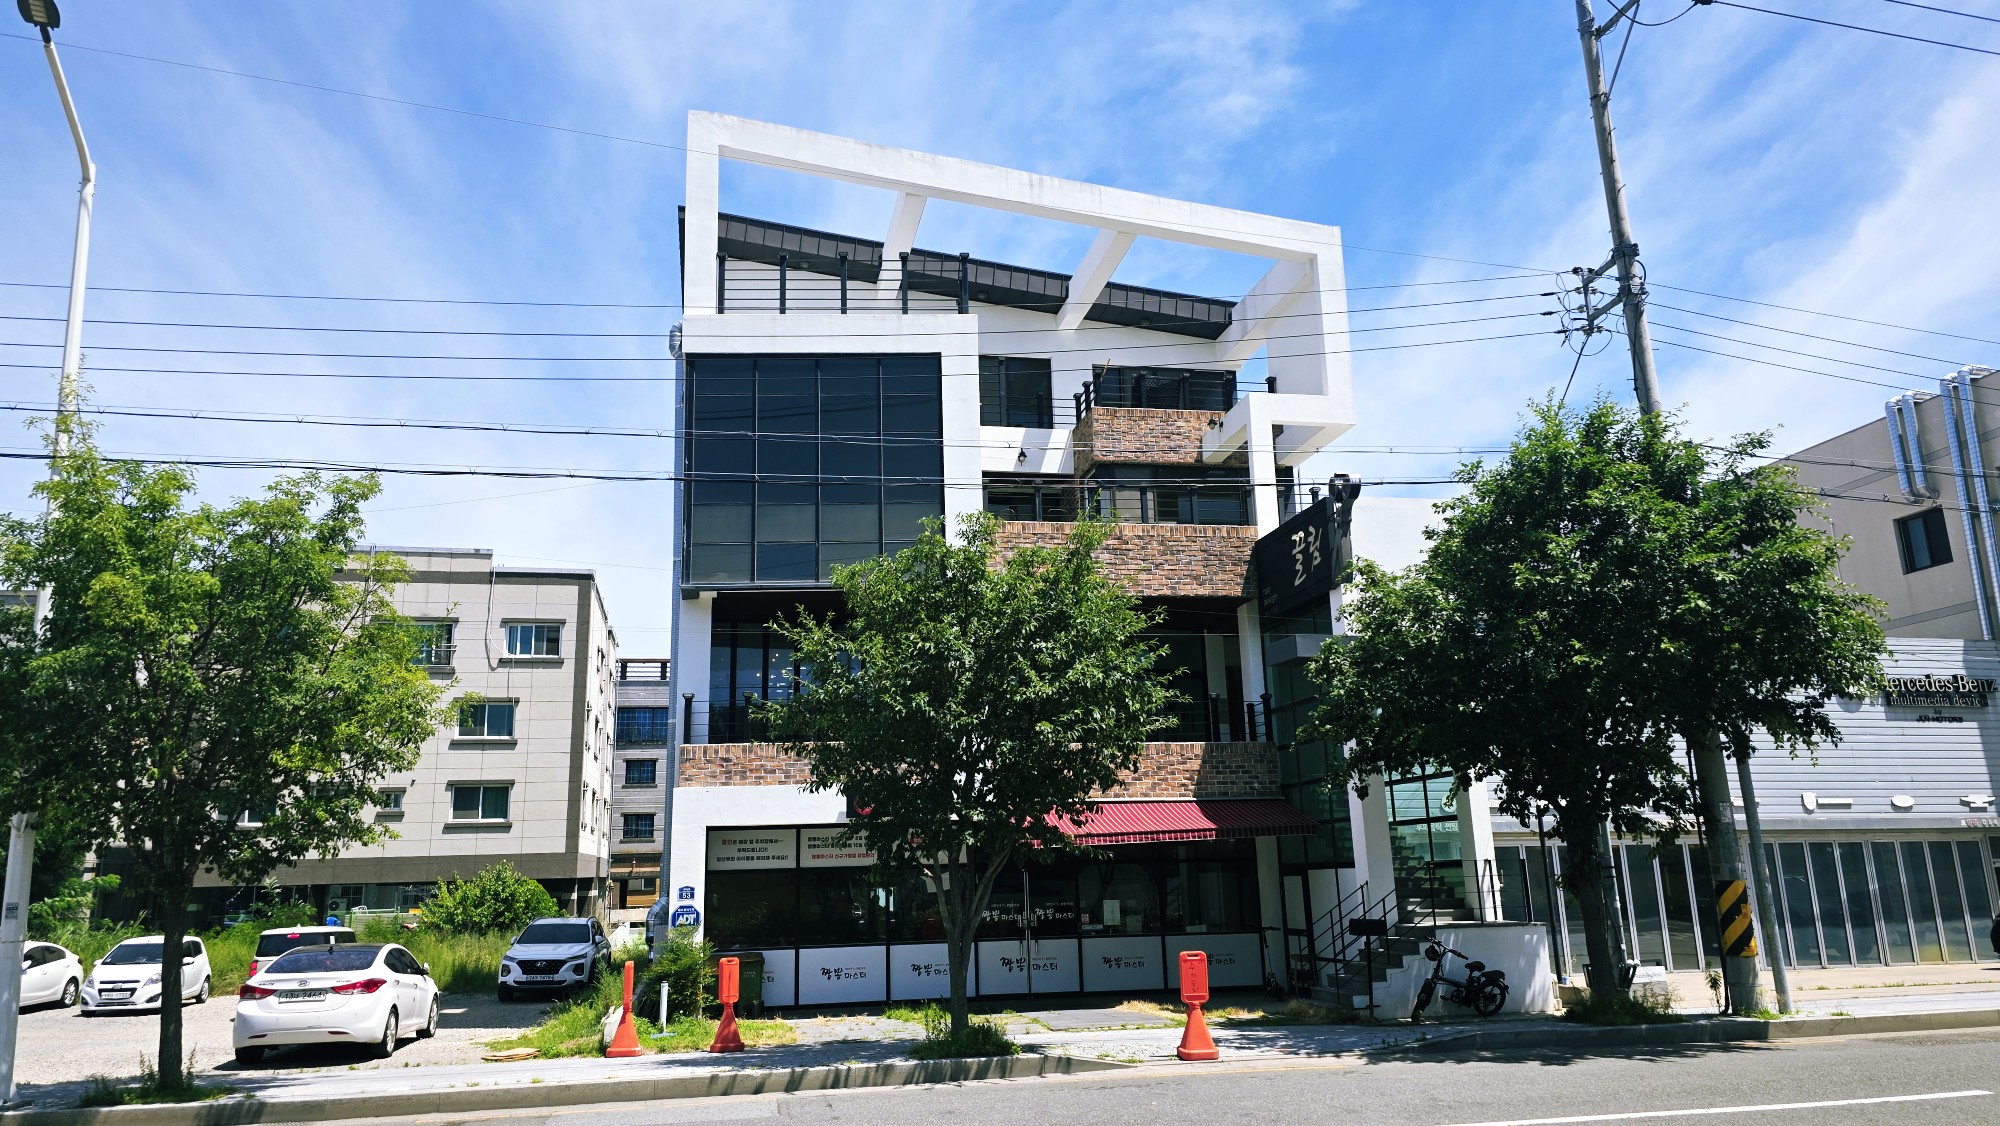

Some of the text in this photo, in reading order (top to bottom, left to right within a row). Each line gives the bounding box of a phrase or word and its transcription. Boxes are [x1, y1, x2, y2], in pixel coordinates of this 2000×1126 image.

[1291, 525, 1322, 587] 끌림
[1264, 593, 1278, 606] design
[1890, 694, 1988, 706] multimedia device
[676, 914, 696, 926] ADT
[1000, 956, 1058, 973] 짬뽕 마스터
[1101, 956, 1123, 969] 짬뽕
[820, 967, 867, 980] 짬뽕 마스터
[911, 963, 949, 976] 짬뽕 마스
